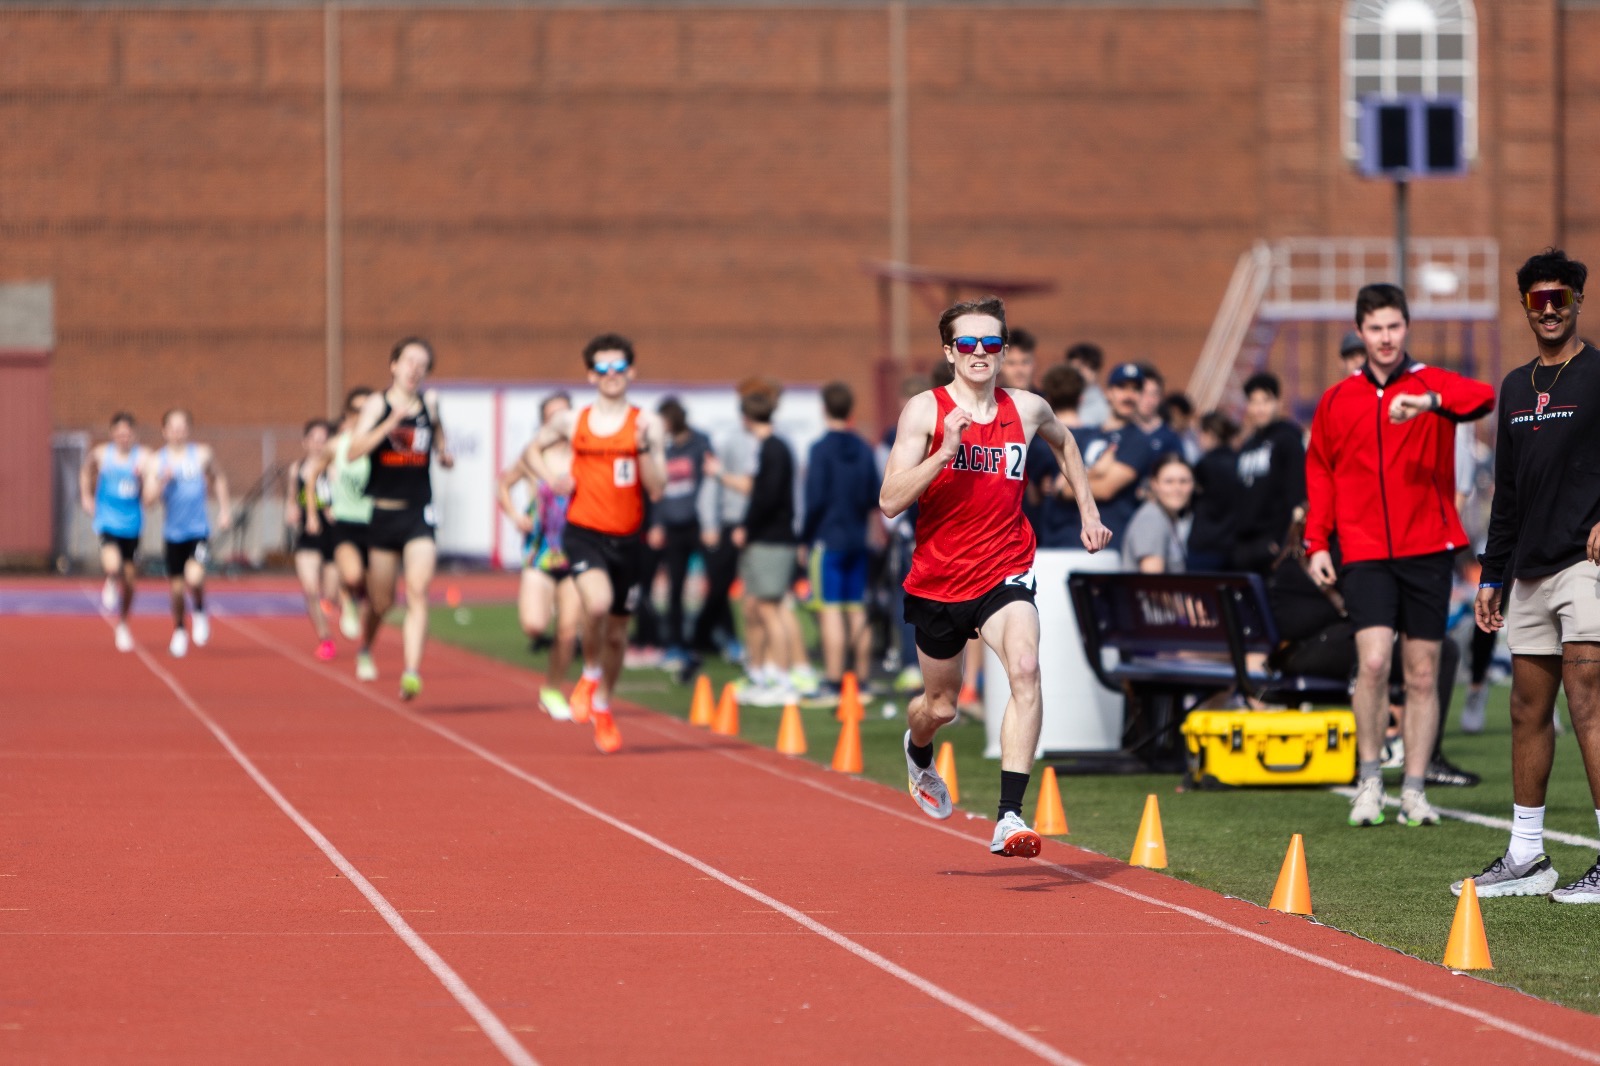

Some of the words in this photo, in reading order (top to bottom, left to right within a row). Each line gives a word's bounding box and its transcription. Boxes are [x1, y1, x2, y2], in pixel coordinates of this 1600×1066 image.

[1535, 393, 1550, 414] P
[1536, 411, 1574, 421] COUNTRY
[618, 461, 629, 480] 4
[1010, 444, 1023, 478] 2
